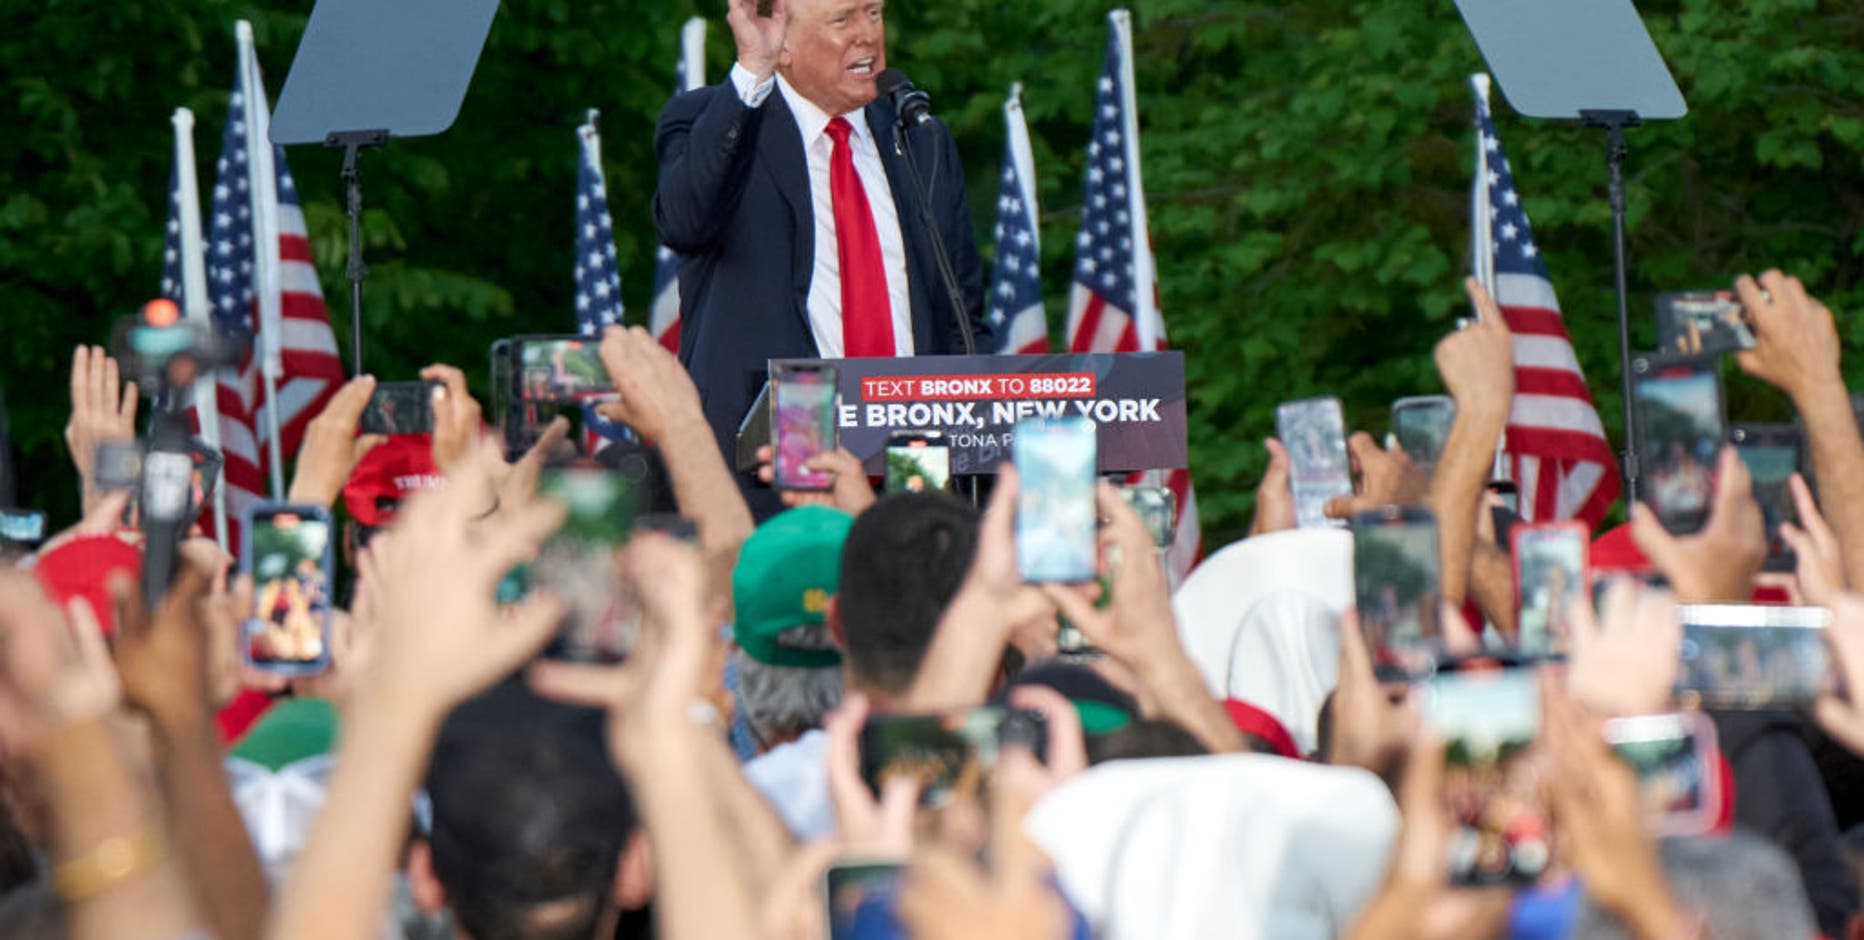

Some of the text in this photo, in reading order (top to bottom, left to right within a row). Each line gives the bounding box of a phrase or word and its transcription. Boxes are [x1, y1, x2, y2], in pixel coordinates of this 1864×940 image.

[864, 376, 1092, 397] TEXT BRONX TO 88022
[865, 401, 985, 430] BRONX,
[992, 399, 1067, 425] NEW
[1074, 398, 1162, 423] YORK
[948, 433, 999, 448] TONA
